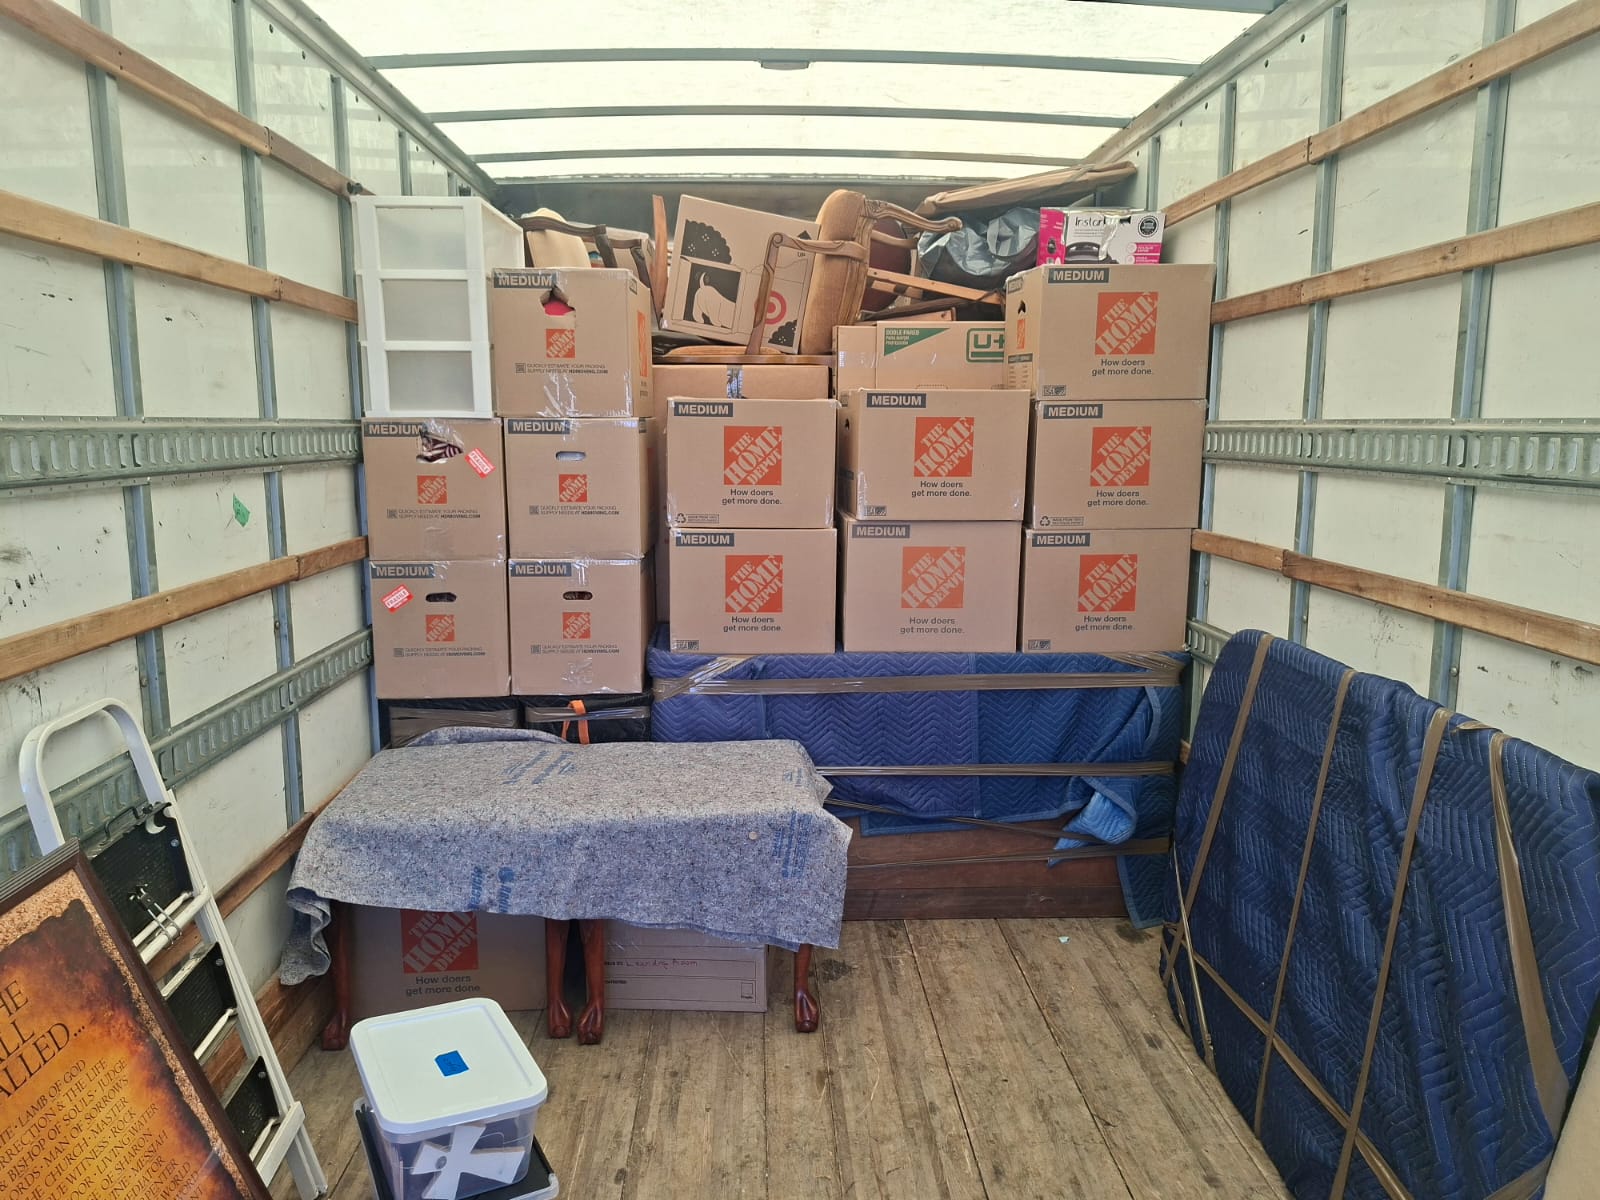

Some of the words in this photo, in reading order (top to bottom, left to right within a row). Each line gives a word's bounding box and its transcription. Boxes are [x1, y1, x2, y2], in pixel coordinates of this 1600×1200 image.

[498, 275, 553, 286] MEDIUM
[1053, 270, 1104, 281] MEDIUM
[1102, 299, 1128, 323] THE
[1095, 292, 1158, 355] HOME
[1118, 315, 1157, 355] DEPOT
[1092, 368, 1105, 376] get
[678, 405, 729, 415] MEDIUM
[871, 395, 922, 406] MEDIUM
[1048, 407, 1099, 417] MEDIUM
[369, 424, 423, 435] MEDIUM
[513, 421, 565, 432] MEDIUM
[920, 423, 946, 447] THE
[729, 432, 754, 455] THE
[914, 417, 975, 477] HOME
[1097, 433, 1123, 456] THE
[724, 426, 782, 485] HOME
[746, 448, 782, 485] DEPOT
[936, 440, 973, 477] DEPOT
[1090, 427, 1152, 486] HOME
[1114, 449, 1151, 486] DEPOT
[730, 488, 748, 496] How
[751, 488, 774, 496] doers
[911, 489, 925, 498] get
[949, 489, 972, 497] done.
[920, 480, 938, 488] How
[941, 480, 963, 488] doers
[722, 497, 735, 506] get
[760, 497, 782, 505] done.
[1088, 499, 1101, 507] get
[680, 535, 730, 545] MEDIUM
[856, 527, 906, 536] MEDIUM
[1037, 535, 1086, 545] MEDIUM
[376, 566, 429, 577] MEDIUM
[515, 564, 567, 575] MEDIUM
[730, 561, 755, 584] THE
[908, 553, 935, 577] THE
[1085, 561, 1109, 584] THE
[725, 555, 783, 612] HOME
[901, 547, 966, 608] HOME
[926, 569, 965, 608] DEPOT
[1078, 554, 1138, 612] HOME
[387, 590, 407, 606] FRAGILE
[747, 576, 783, 613] DEPOT
[1100, 576, 1136, 612] DEPOT
[900, 626, 914, 634] get
[941, 626, 965, 634] done.
[909, 617, 928, 625] How
[931, 617, 955, 625] doers
[1075, 624, 1088, 632] get
[432, 927, 478, 971] DEPOT
[406, 987, 423, 996] get
[425, 986, 452, 994] more
[415, 976, 439, 985] How
[442, 975, 472, 983] doers
[18, 1095, 48, 1128] LAMB
[48, 1080, 63, 1099] OF
[64, 1059, 87, 1084] GOD
[57, 1102, 66, 1112] &
[63, 1080, 87, 1102] THE
[86, 1059, 108, 1083] LIFE
[7, 1138, 46, 1182] BISHOP
[47, 1121, 63, 1141] OF
[62, 1091, 95, 1123] SOULS
[98, 1059, 128, 1092] JUDGE
[42, 1136, 70, 1167] MAN
[69, 1120, 84, 1139] OF
[84, 1078, 129, 1122] SORROWS
[44, 1137, 89, 1187] CHURCH
[91, 1096, 129, 1136] MASTER
[65, 1140, 109, 1185] WITNESS
[110, 1106, 137, 1138] ROCK
[96, 1136, 131, 1175] LIVING
[130, 1103, 159, 1136] WATER
[100, 1170, 115, 1191] OF
[114, 1132, 153, 1174] SHARON
[131, 1130, 168, 1174] MESSIAH
[161, 1161, 191, 1199] WORLD
